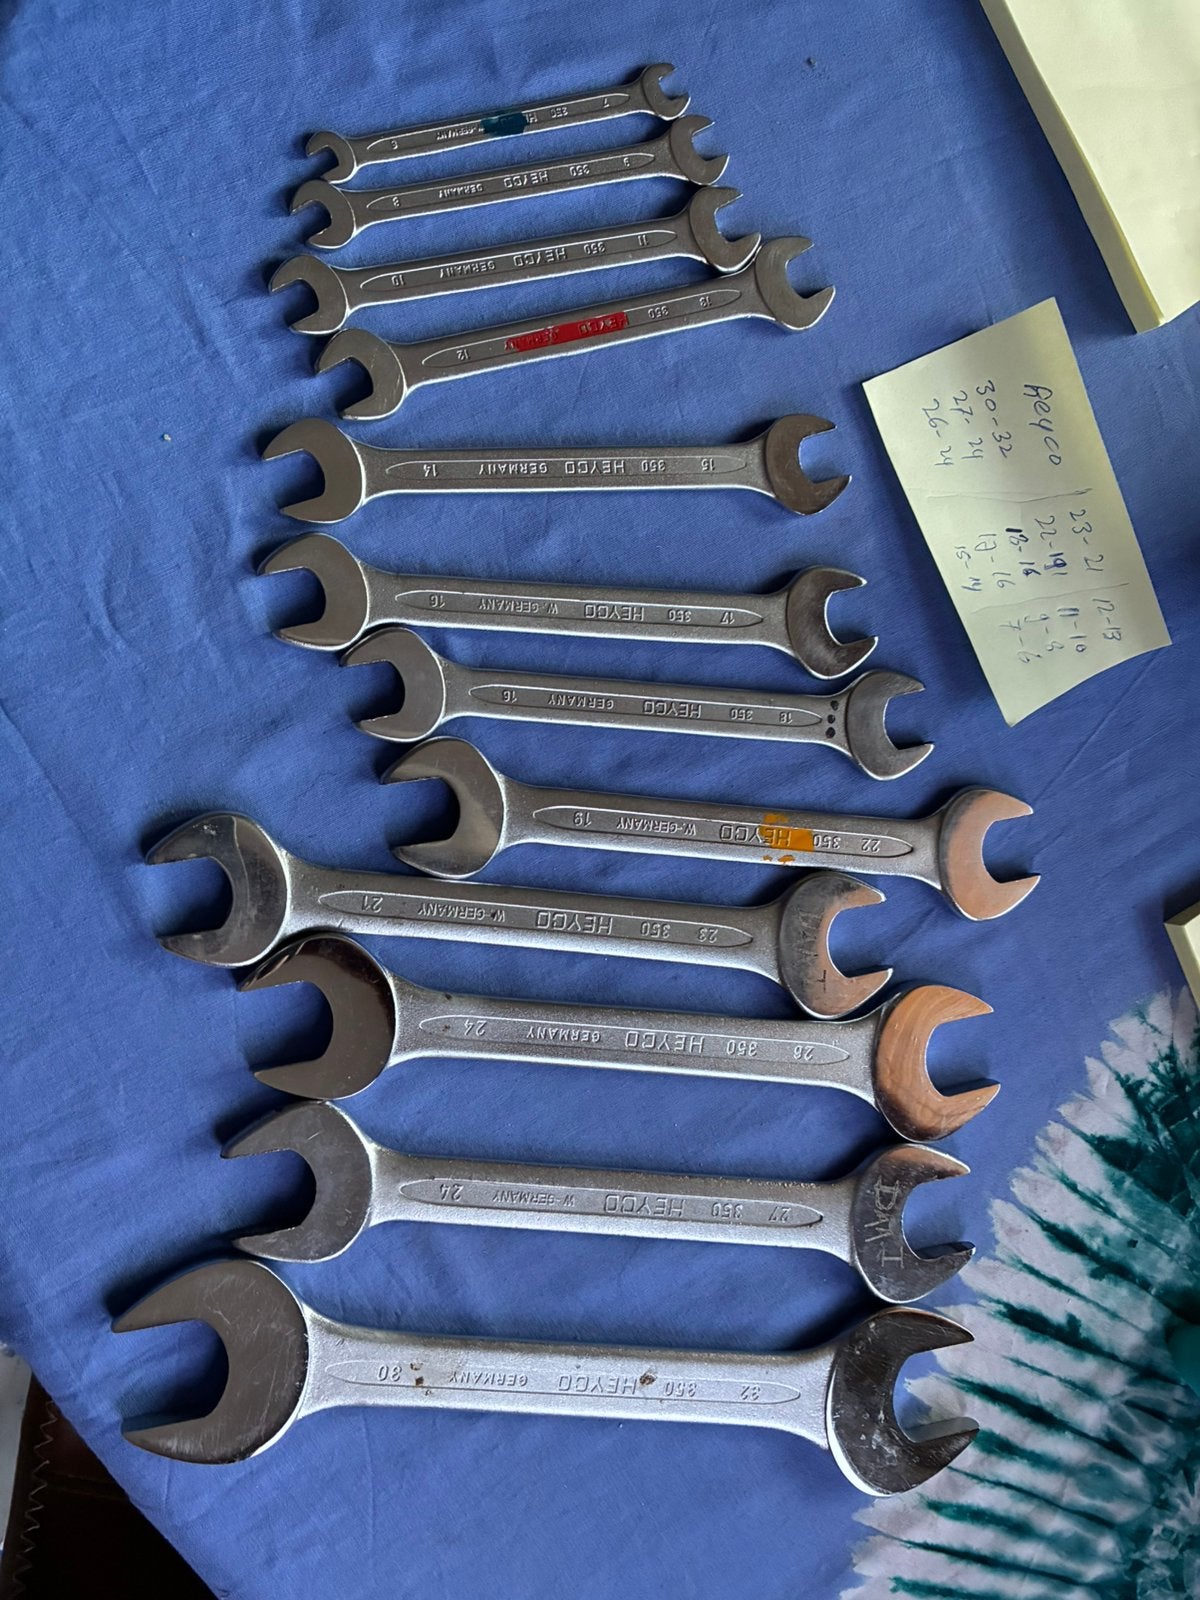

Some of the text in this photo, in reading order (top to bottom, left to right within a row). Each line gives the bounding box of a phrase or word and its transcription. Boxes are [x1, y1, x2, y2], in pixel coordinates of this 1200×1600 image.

[503, 170, 549, 188] HEYCO
[569, 164, 589, 178] 350
[438, 183, 483, 199] GERMANY
[513, 246, 567, 267] HEYCO
[583, 242, 606, 256] 350
[439, 261, 496, 279] GERMANY
[647, 306, 669, 319] 350
[477, 462, 548, 476] GERMANY
[563, 461, 625, 475] HEYCO
[641, 460, 666, 472] 350
[584, 603, 645, 622] HEYCO
[667, 609, 692, 623] 350
[547, 693, 614, 709] GERMANY
[643, 700, 702, 719] HEYCO
[730, 708, 753, 721] 350
[719, 823, 792, 846] HEYCO
[812, 834, 841, 850] 350
[535, 910, 614, 935] HEYCO
[640, 921, 671, 938] 350
[526, 1025, 601, 1044] GERMANY
[624, 1031, 705, 1054] HEYCO
[726, 1038, 758, 1056] 350
[603, 1194, 686, 1218] HEYCO
[711, 1202, 744, 1221] 350
[448, 1371, 529, 1387] GERMANY
[557, 1375, 639, 1396] HEYCO
[663, 1381, 698, 1398] 350
